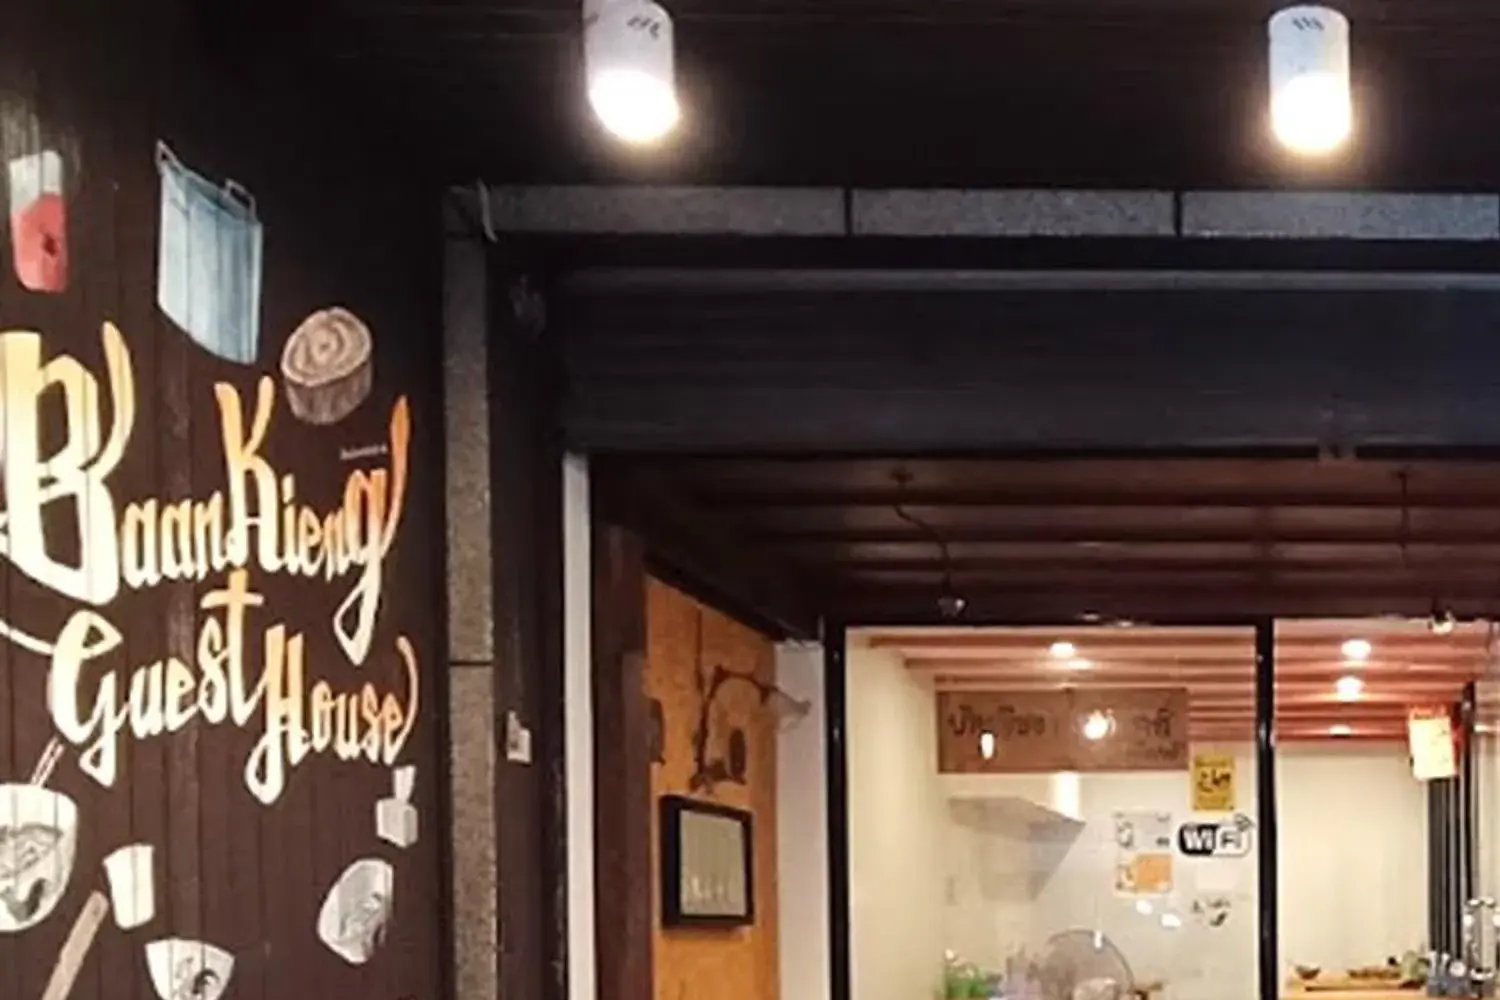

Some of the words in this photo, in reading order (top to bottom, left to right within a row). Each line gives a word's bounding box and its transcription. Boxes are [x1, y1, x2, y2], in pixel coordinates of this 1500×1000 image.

[0, 321, 230, 606] Baan
[213, 375, 411, 666] Kieng
[47, 570, 264, 788] Guest
[246, 623, 419, 804] House
